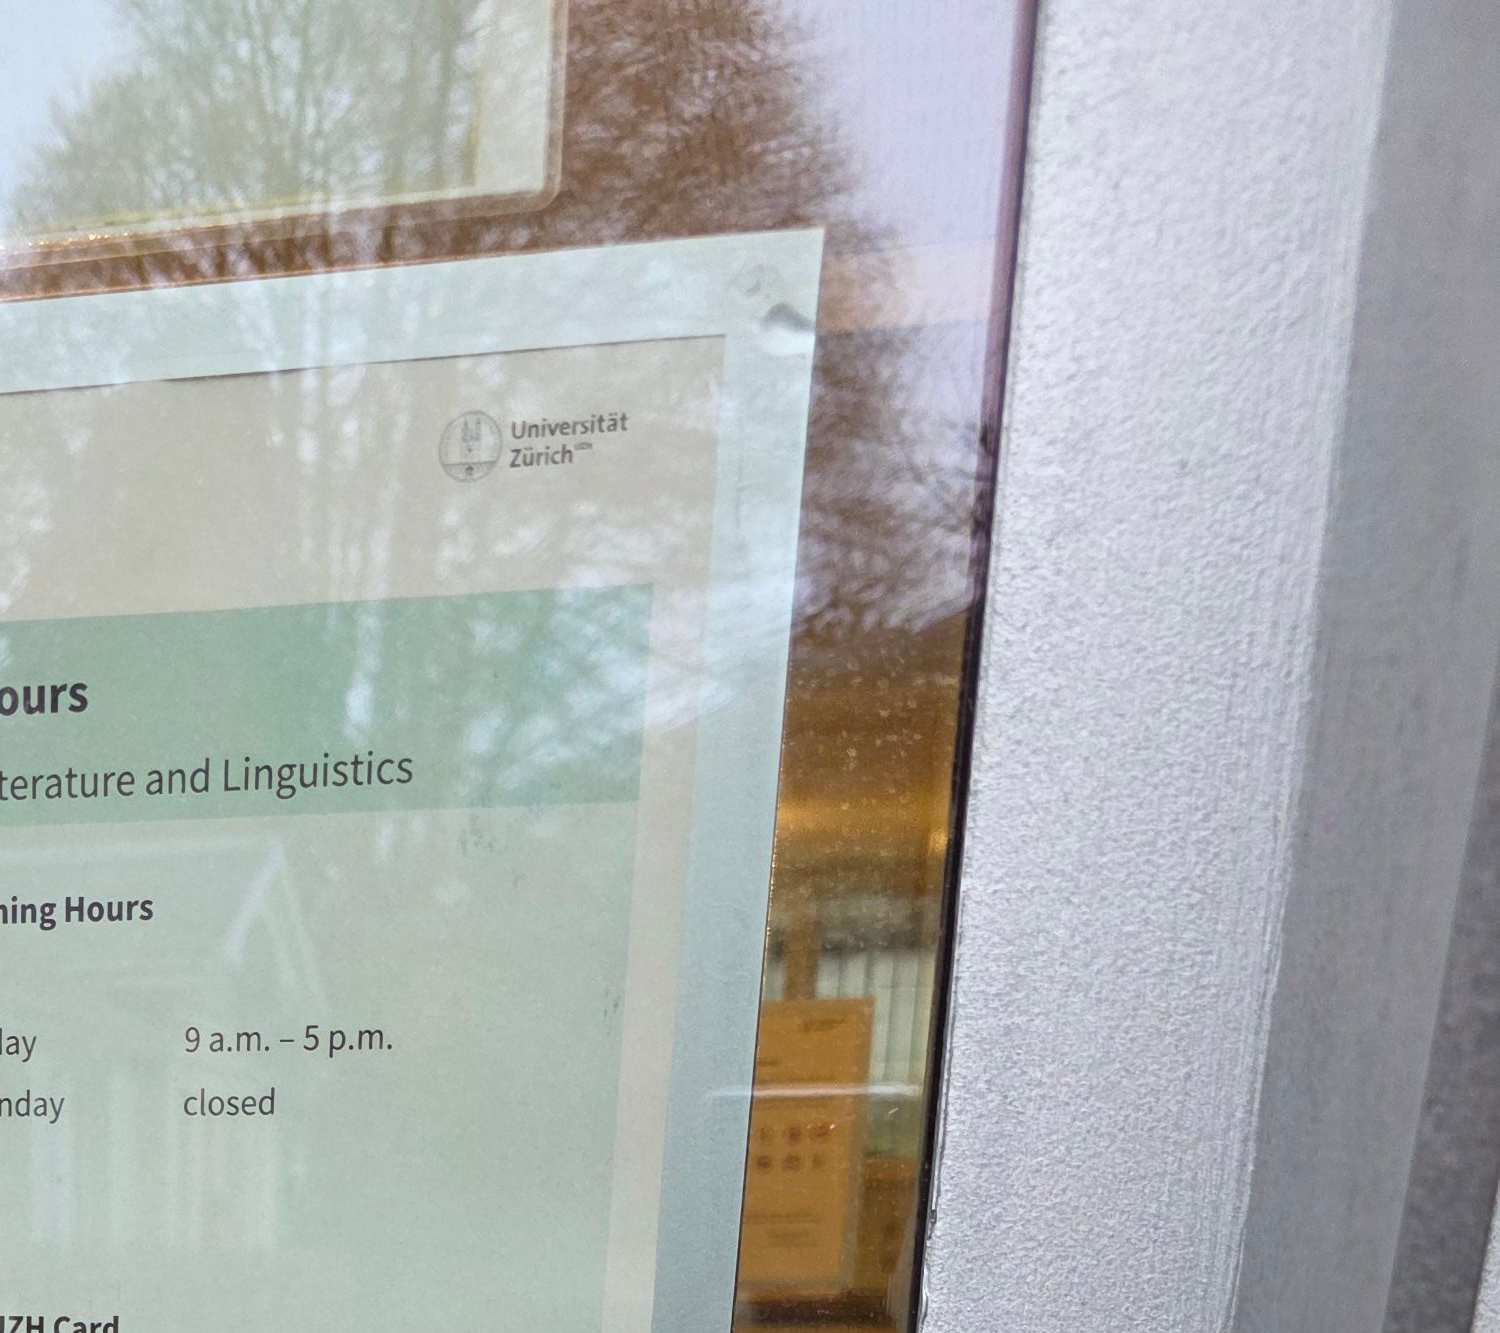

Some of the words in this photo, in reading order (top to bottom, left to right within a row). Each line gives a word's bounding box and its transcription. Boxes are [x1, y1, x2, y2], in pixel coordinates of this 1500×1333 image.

[511, 412, 629, 440] Universität
[510, 444, 573, 468] Zürich
[145, 757, 210, 796] and
[223, 750, 413, 800] Linguistics
[65, 896, 154, 923] Hours
[185, 1026, 201, 1053] 9
[209, 1031, 270, 1053] a.m.
[303, 1024, 320, 1051] 5
[328, 1029, 393, 1059] p.m.
[183, 1086, 276, 1117] closed
